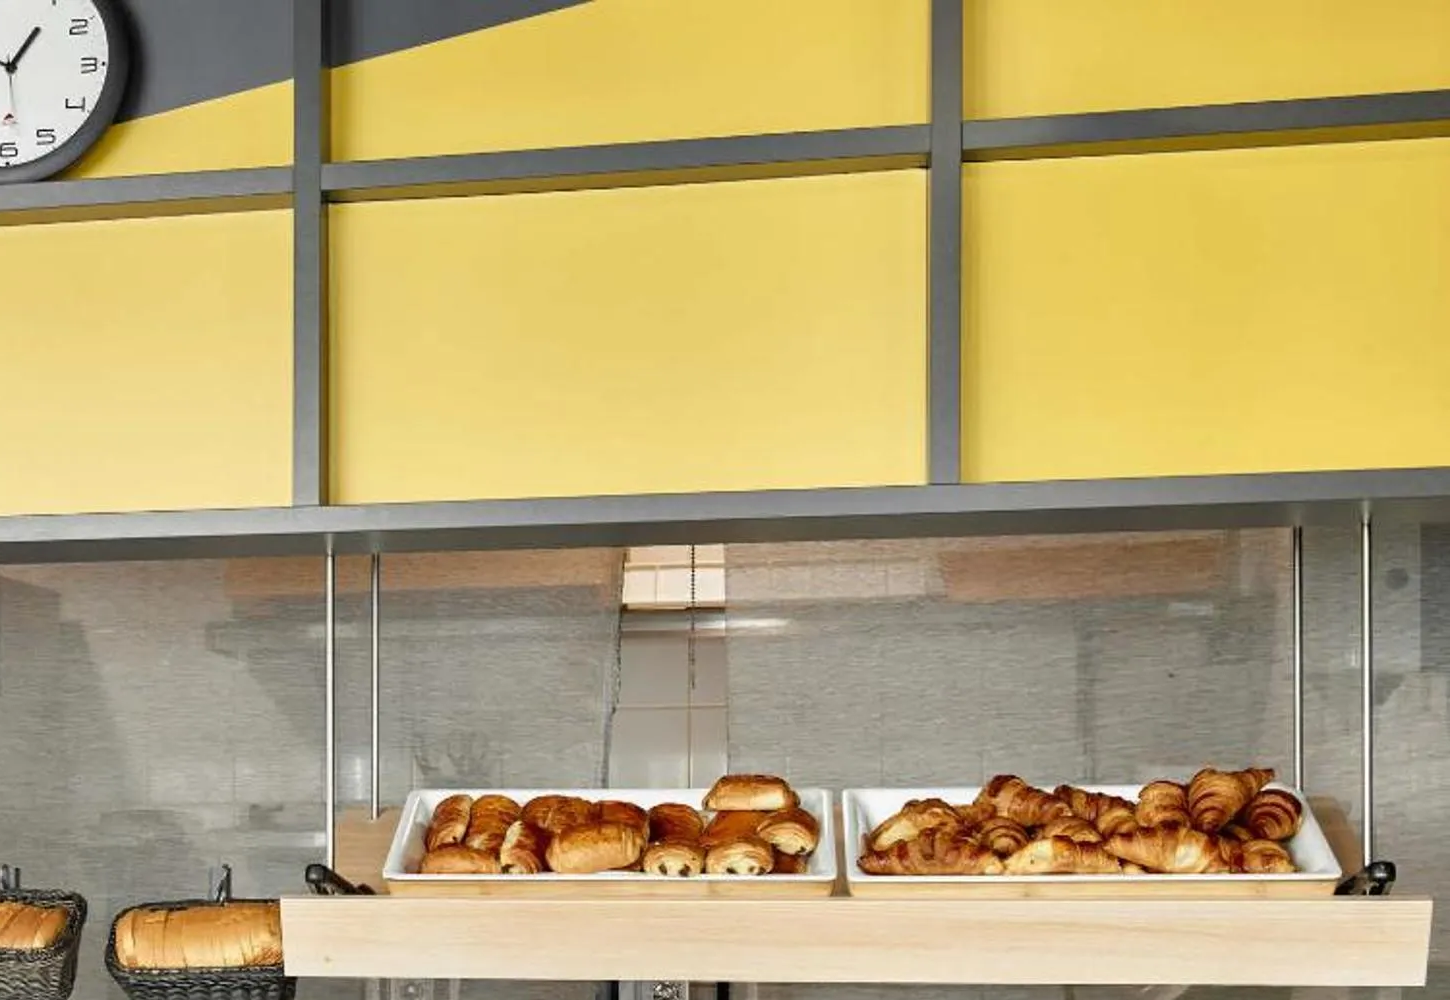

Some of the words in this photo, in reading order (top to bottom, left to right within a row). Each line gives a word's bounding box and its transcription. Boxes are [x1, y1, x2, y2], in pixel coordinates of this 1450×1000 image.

[69, 18, 88, 36] 2
[80, 56, 98, 74] 3
[65, 97, 86, 113] 4
[36, 128, 57, 146] 5
[0, 142, 19, 158] 6
